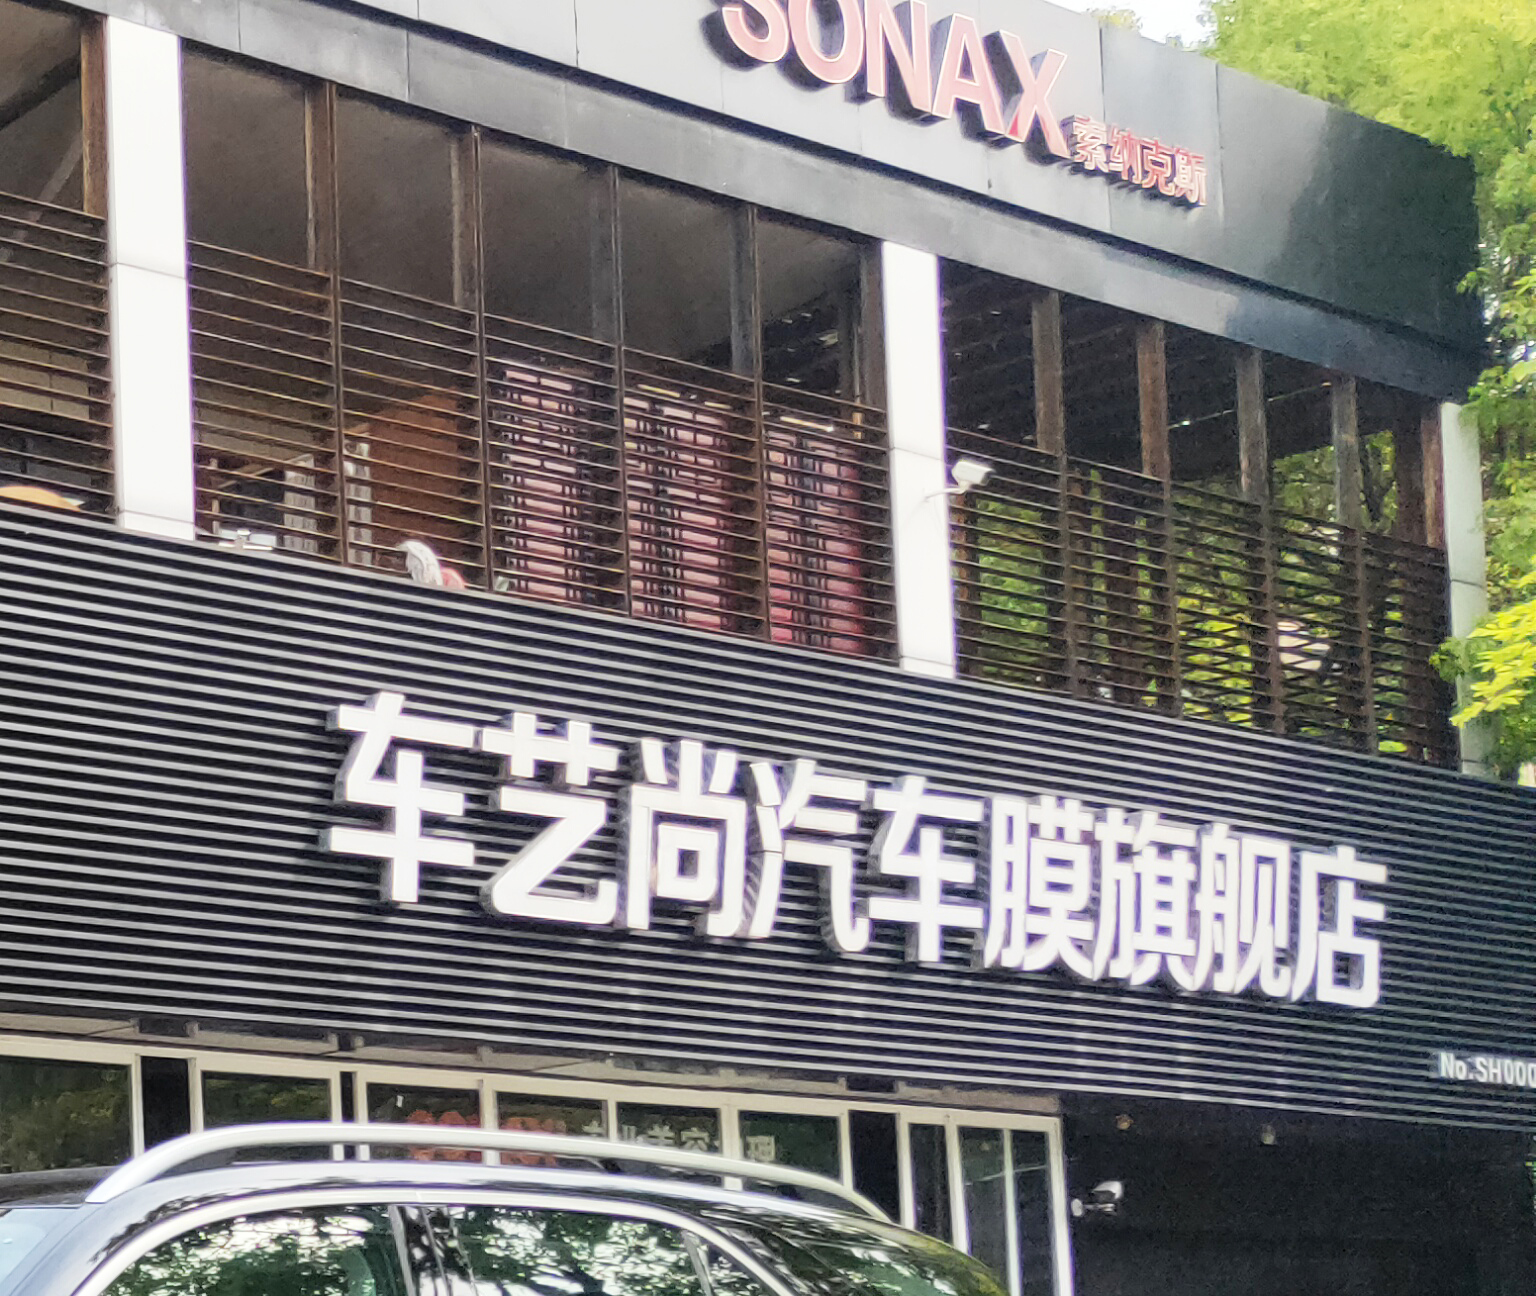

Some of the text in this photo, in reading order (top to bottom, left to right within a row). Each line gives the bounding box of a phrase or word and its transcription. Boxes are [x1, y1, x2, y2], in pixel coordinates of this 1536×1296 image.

[1070, 113, 1207, 206] 索纳克斯
[328, 691, 1389, 1009] 车艺尚汽车膜旗舰店
